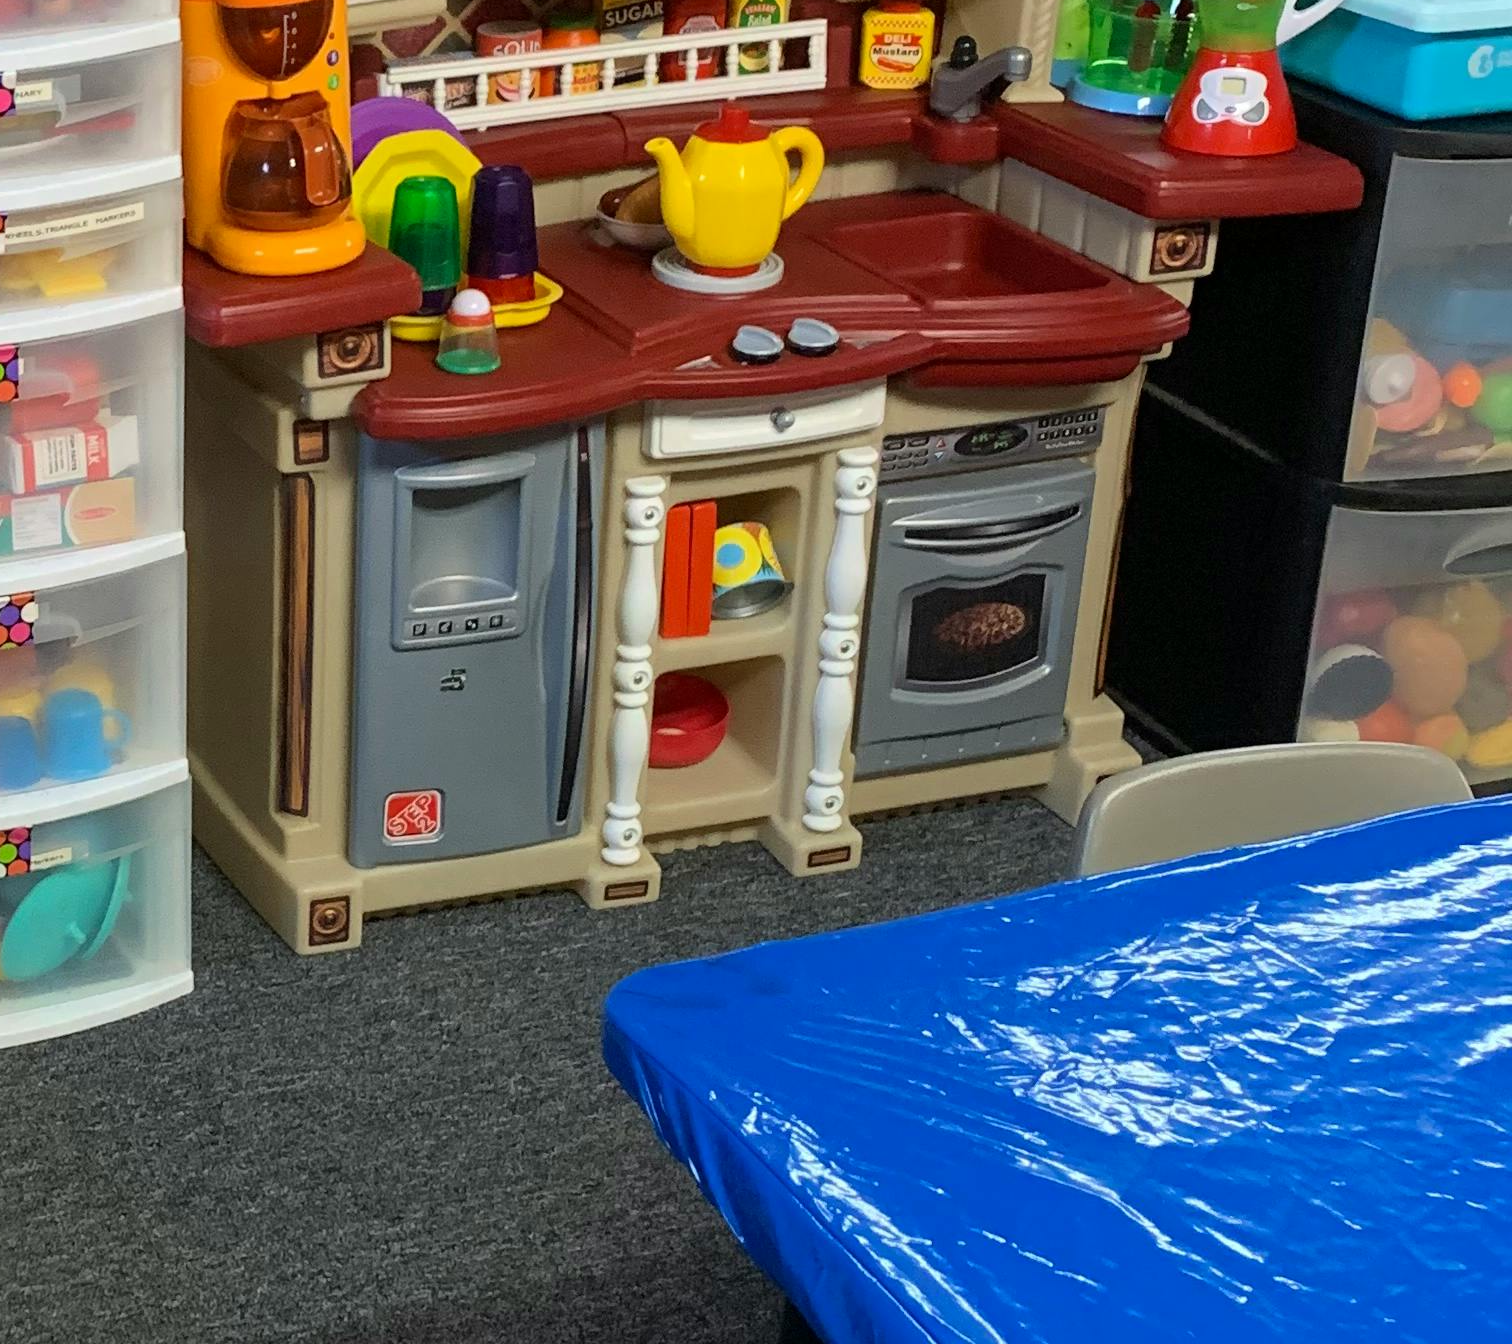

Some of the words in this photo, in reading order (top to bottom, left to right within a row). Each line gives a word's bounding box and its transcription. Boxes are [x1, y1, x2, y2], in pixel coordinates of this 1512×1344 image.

[605, 0, 664, 28] SUGAR
[493, 39, 542, 56] SOUP
[883, 33, 912, 44] DELI
[872, 47, 920, 57] Mustard
[95, 209, 136, 224] MARKERS
[86, 434, 101, 467] MILK
[387, 793, 432, 836] STEP
[414, 814, 437, 834] 2
